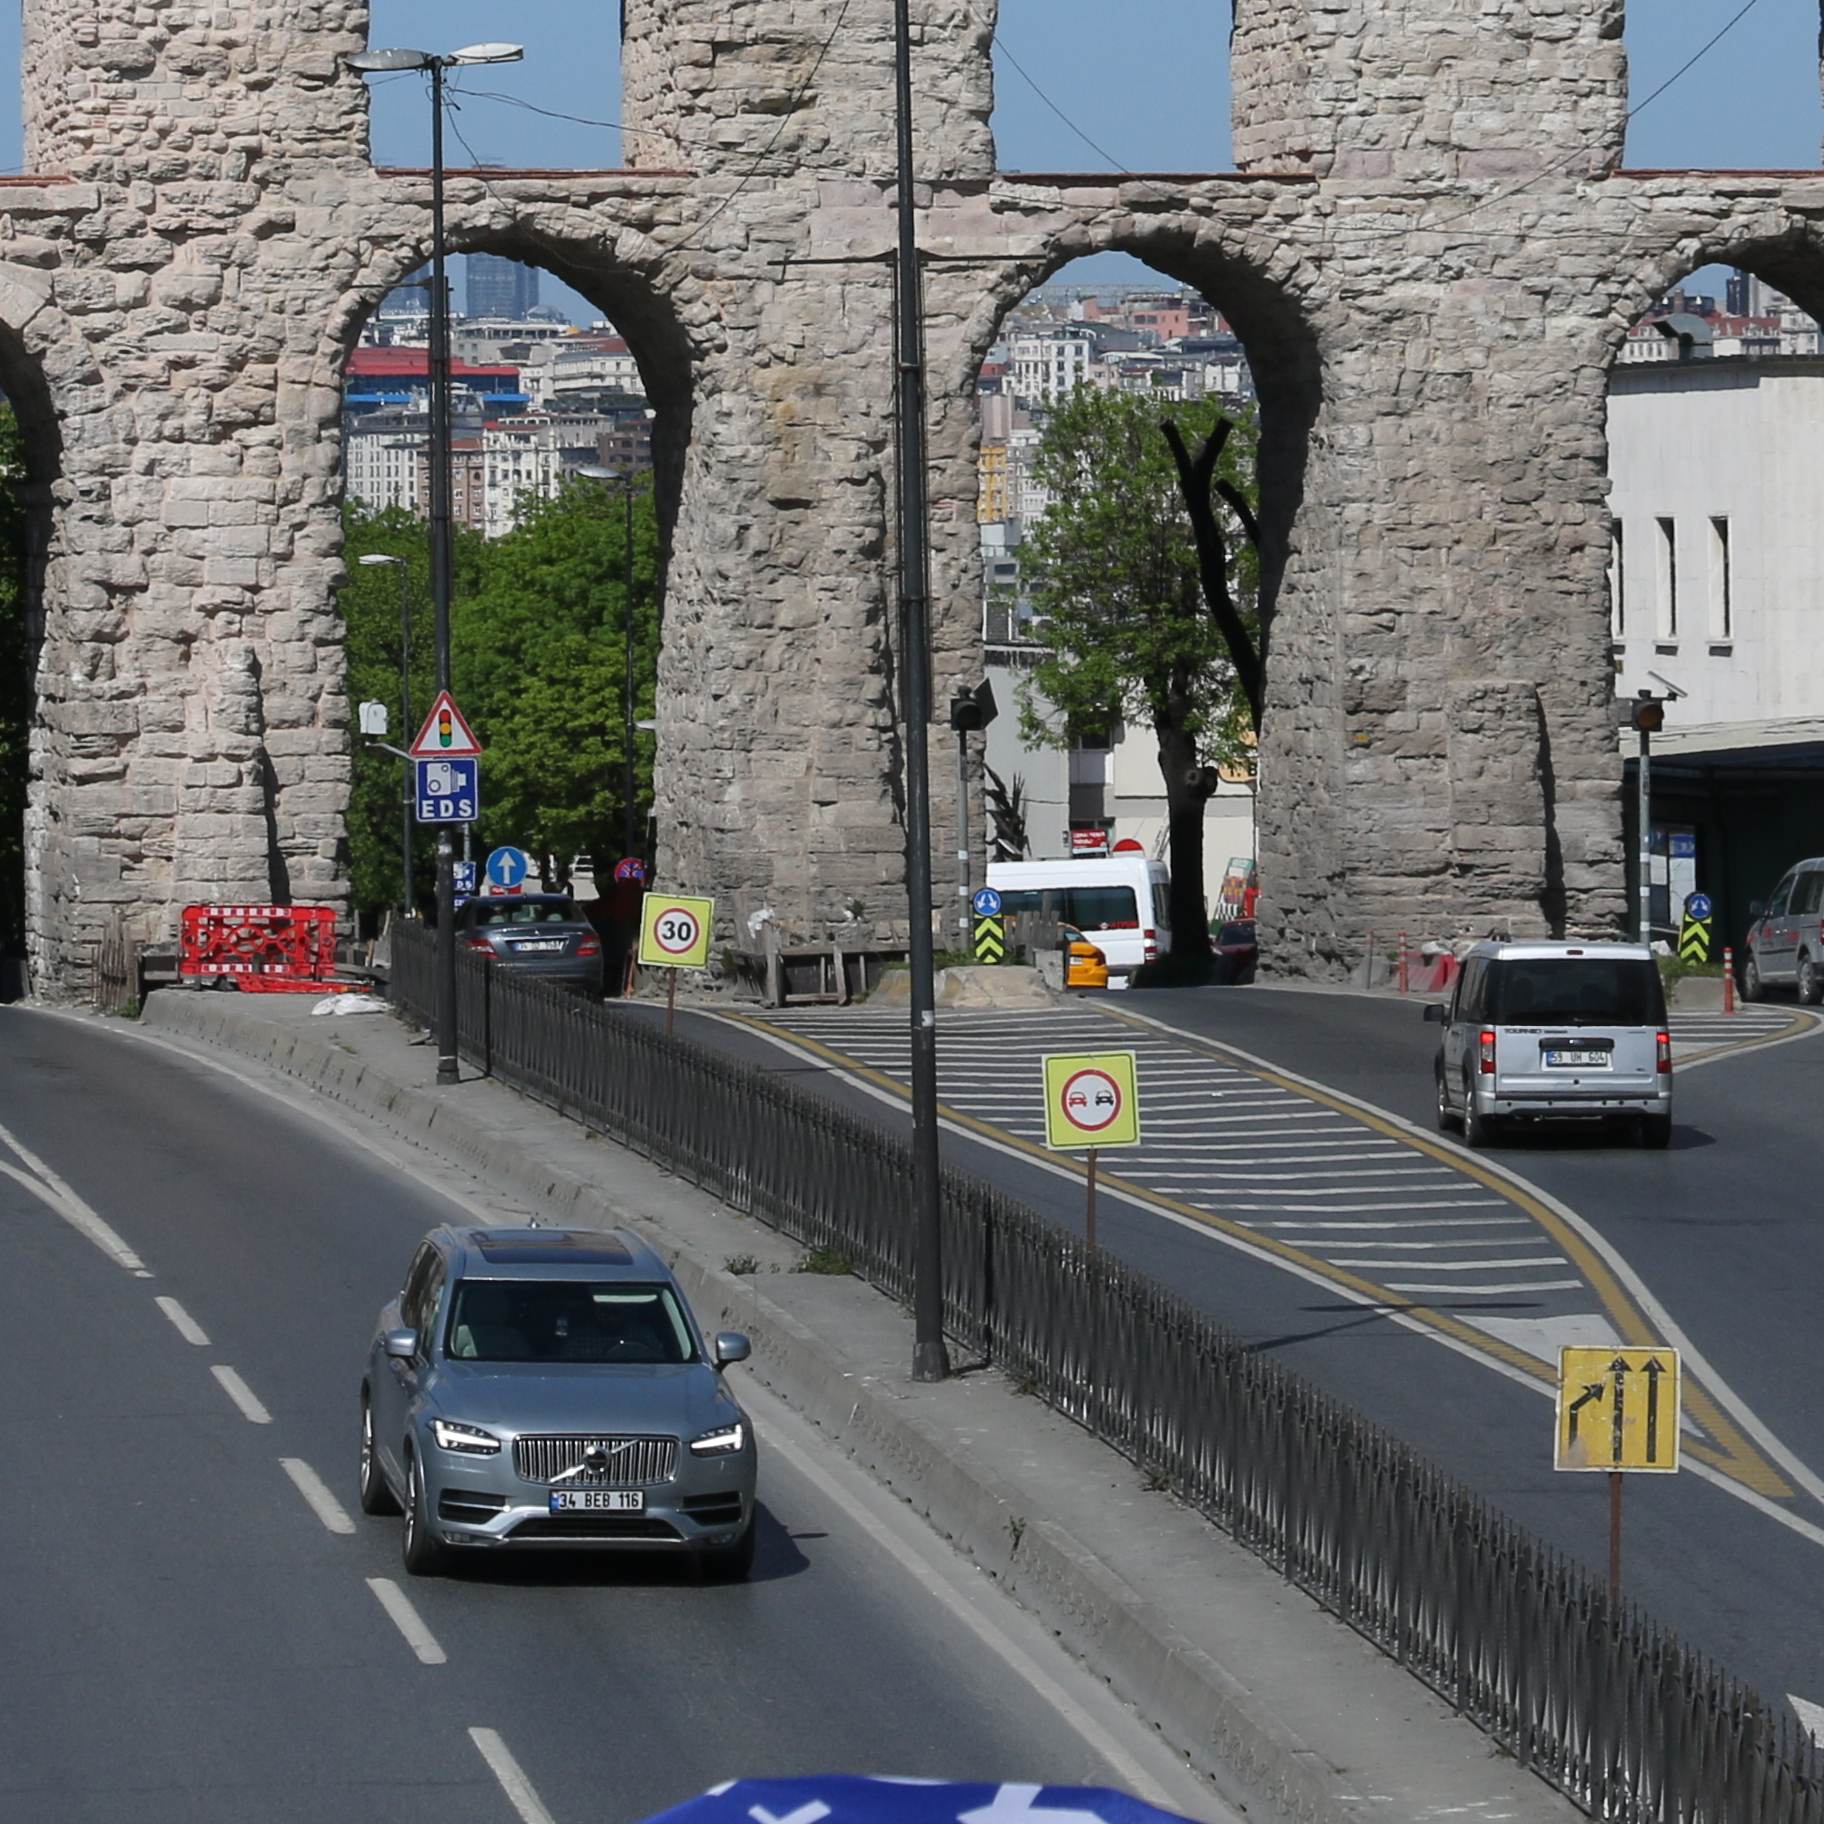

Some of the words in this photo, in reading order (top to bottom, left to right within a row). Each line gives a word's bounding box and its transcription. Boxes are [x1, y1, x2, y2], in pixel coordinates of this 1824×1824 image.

[421, 799, 473, 818] EDS
[662, 920, 691, 942] 30
[559, 1493, 576, 1508] 34
[584, 1493, 611, 1508] BEB
[619, 1493, 639, 1508] 116
